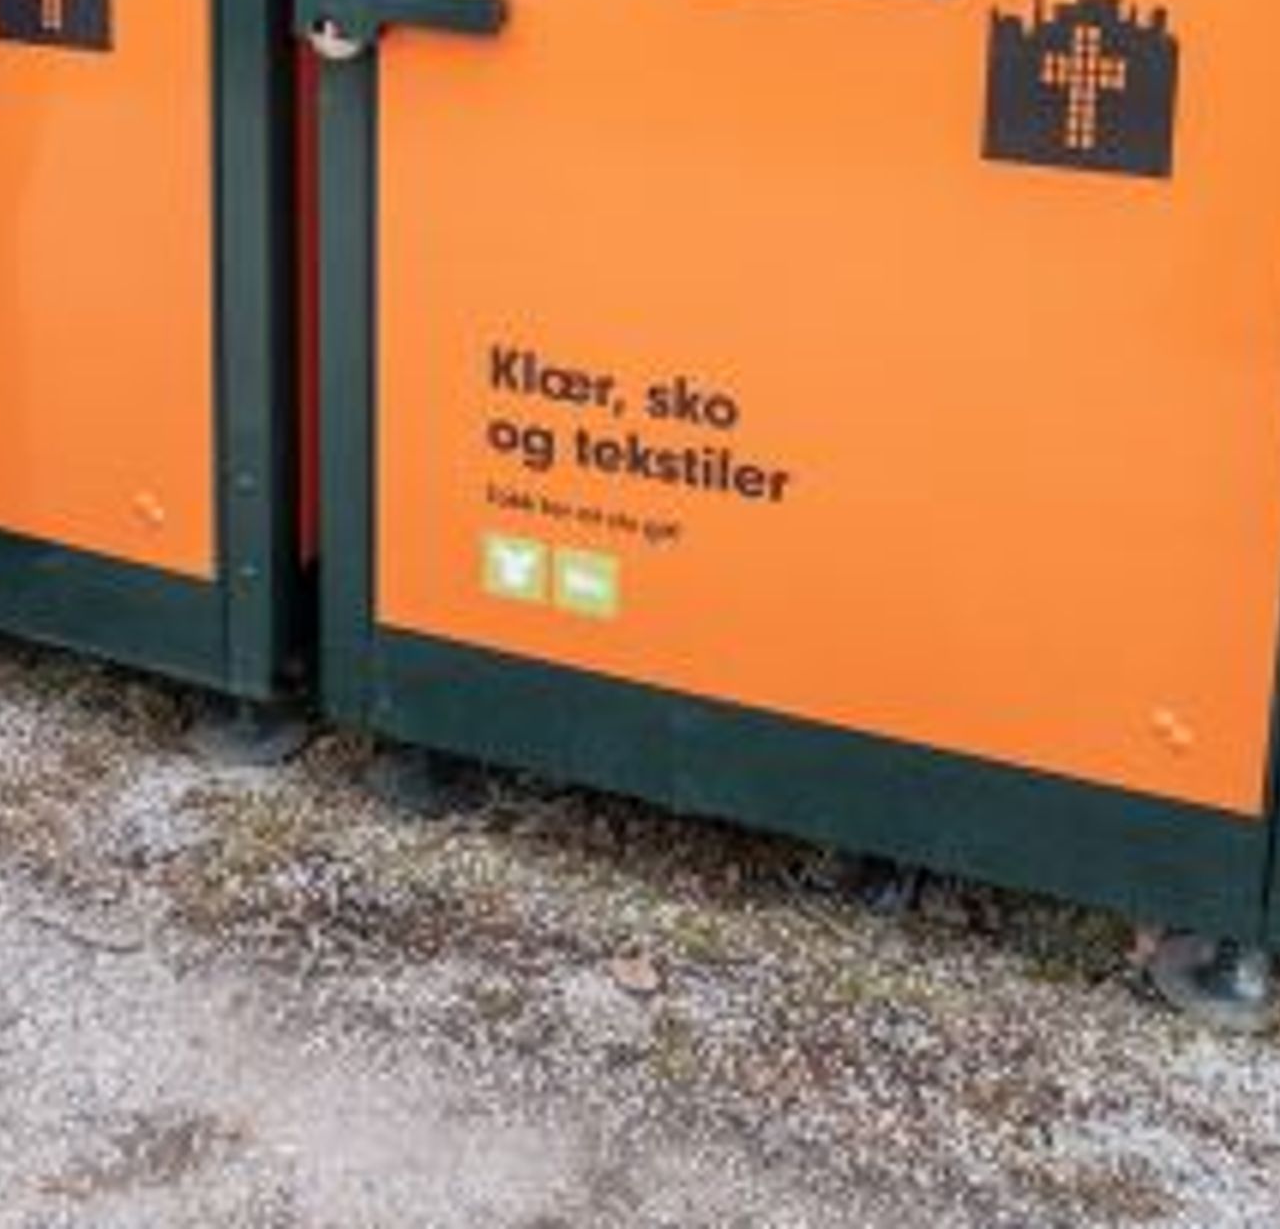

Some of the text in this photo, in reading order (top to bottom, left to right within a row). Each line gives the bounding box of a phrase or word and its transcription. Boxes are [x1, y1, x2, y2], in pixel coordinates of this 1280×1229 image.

[488, 344, 740, 430] Klær, sko
[486, 419, 790, 502] og tekstiler
